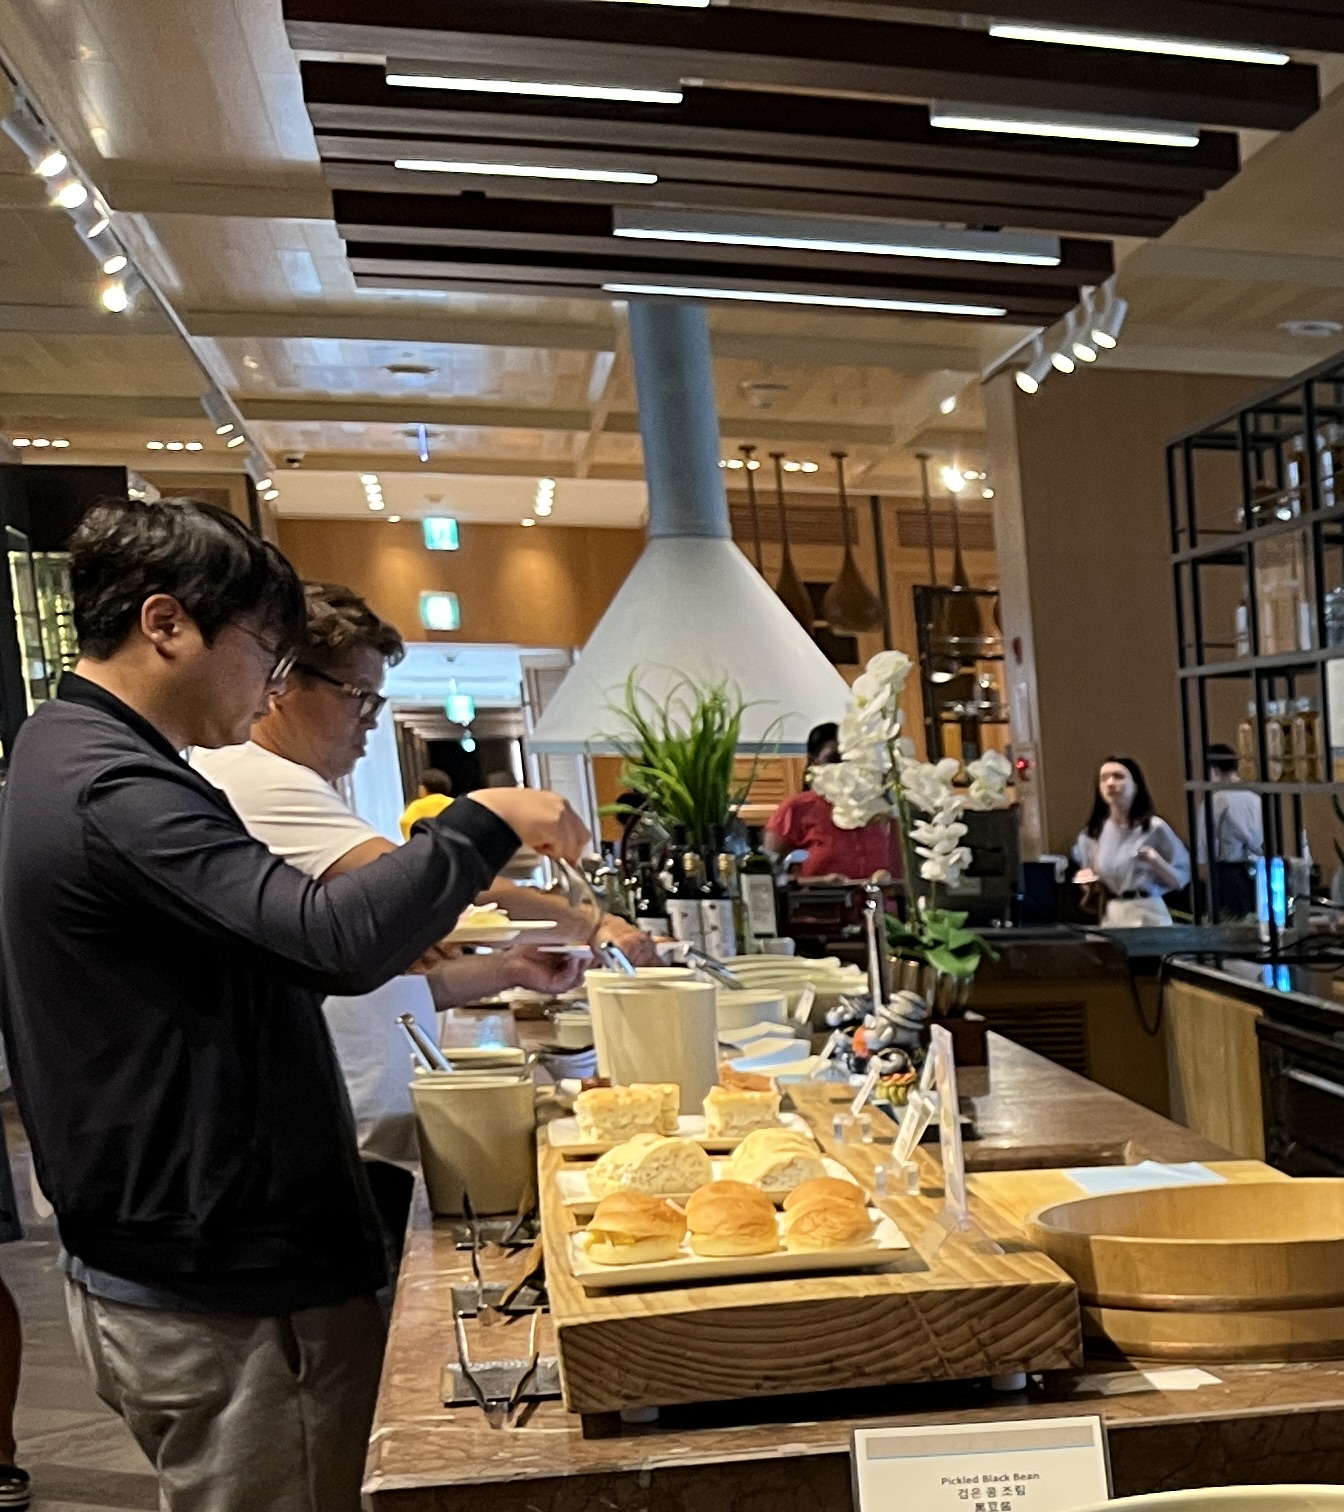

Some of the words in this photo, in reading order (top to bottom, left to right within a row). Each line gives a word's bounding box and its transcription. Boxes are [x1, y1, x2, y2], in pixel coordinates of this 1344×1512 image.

[941, 1475, 979, 1486] Pickled
[982, 1473, 1011, 1483] Black
[1013, 1472, 1040, 1482] Bean
[986, 1486, 997, 1499] 콩
